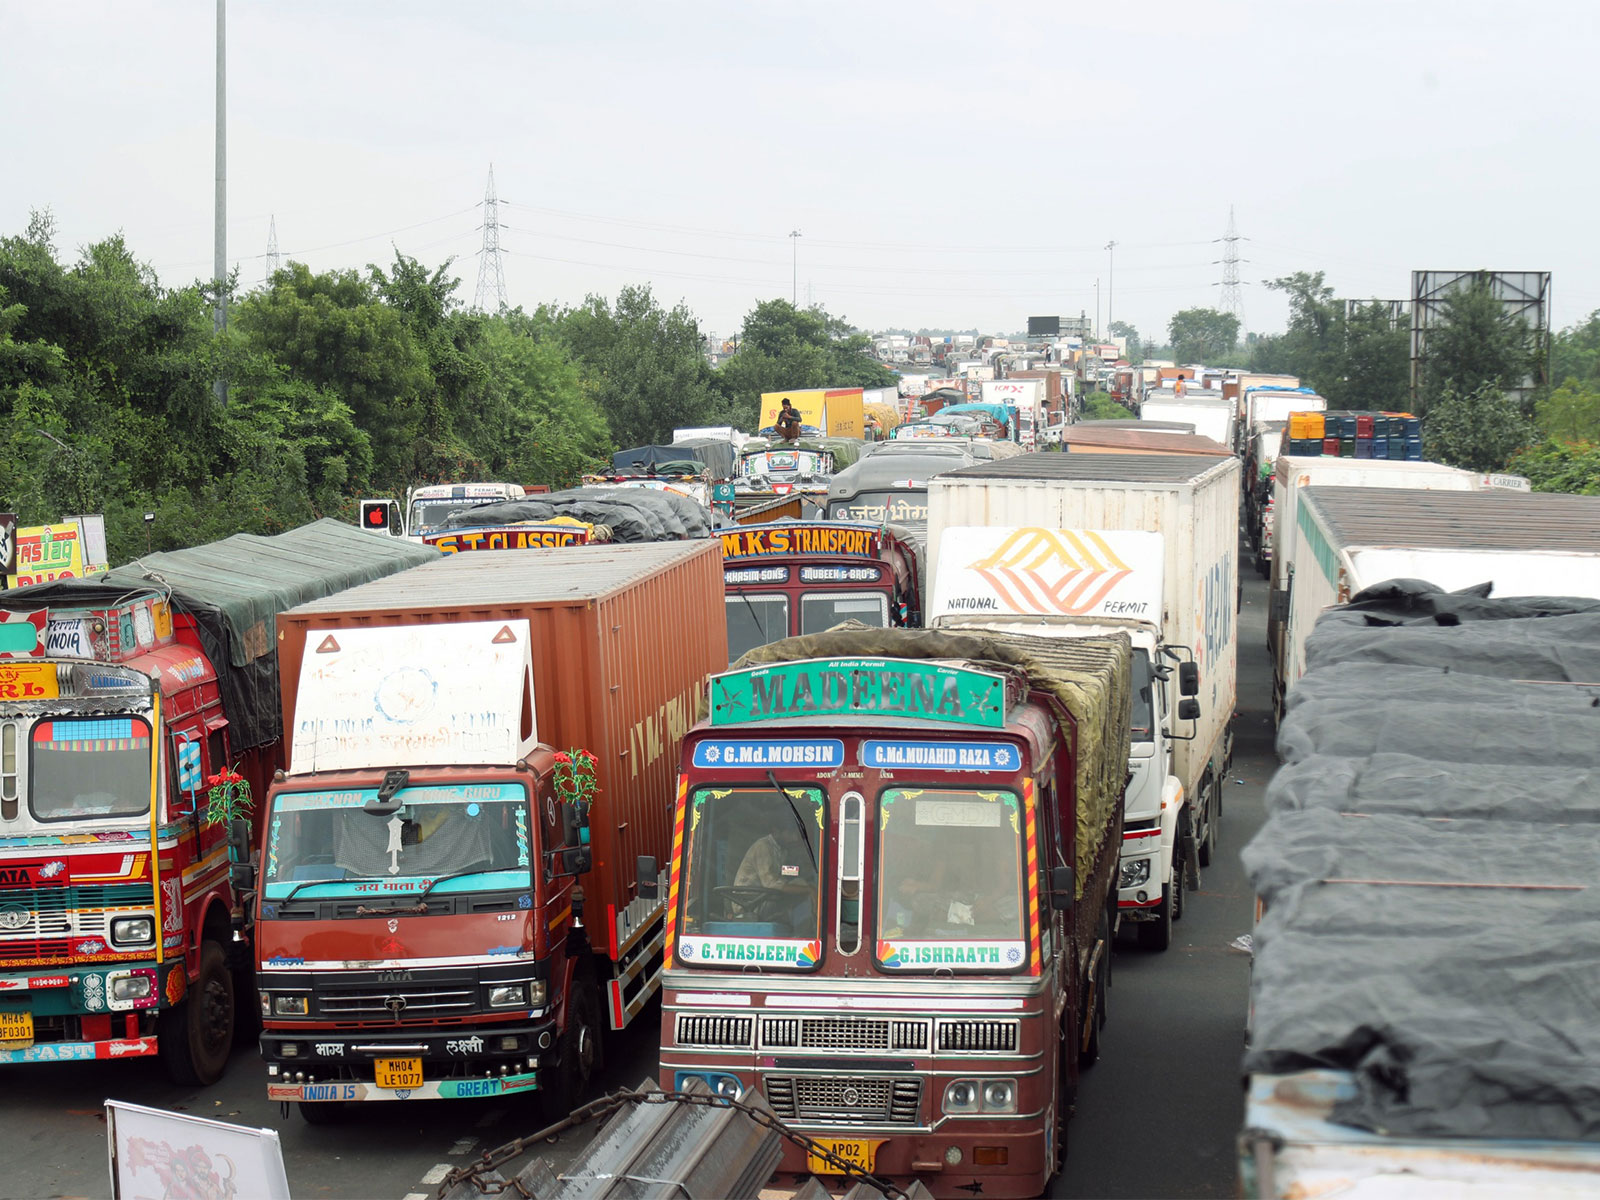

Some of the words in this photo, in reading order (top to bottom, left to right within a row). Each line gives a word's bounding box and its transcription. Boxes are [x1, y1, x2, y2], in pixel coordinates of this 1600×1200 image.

[1493, 477, 1522, 488] CARRIER
[794, 529, 872, 554] TRANSPORT
[841, 569, 848, 579] &
[947, 598, 998, 611] NATIONAL
[1103, 600, 1148, 614] PERMIT
[47, 632, 81, 655] INDIA
[751, 669, 770, 678] Goods
[937, 667, 959, 676] Carrier
[749, 671, 965, 718] MADEENA
[958, 750, 990, 765] RAZA
[463, 787, 501, 799] GURU
[0, 869, 31, 882] ATA
[354, 883, 379, 892] जय
[383, 882, 415, 891] माता
[701, 944, 797, 962] G.THASLEEM
[899, 946, 1000, 963] G.ISHRAATH
[2, 1014, 25, 1025] MH46
[23, 1045, 94, 1061] FAST
[315, 1042, 345, 1057] भाग्य
[446, 1035, 484, 1056] लक्ष्मी
[389, 1060, 413, 1072] MH04
[384, 1073, 421, 1086] LE1077
[303, 1086, 337, 1100] INDIA
[343, 1085, 356, 1100] IS
[457, 1079, 499, 1097] GREAT
[832, 1143, 860, 1156] AP02
